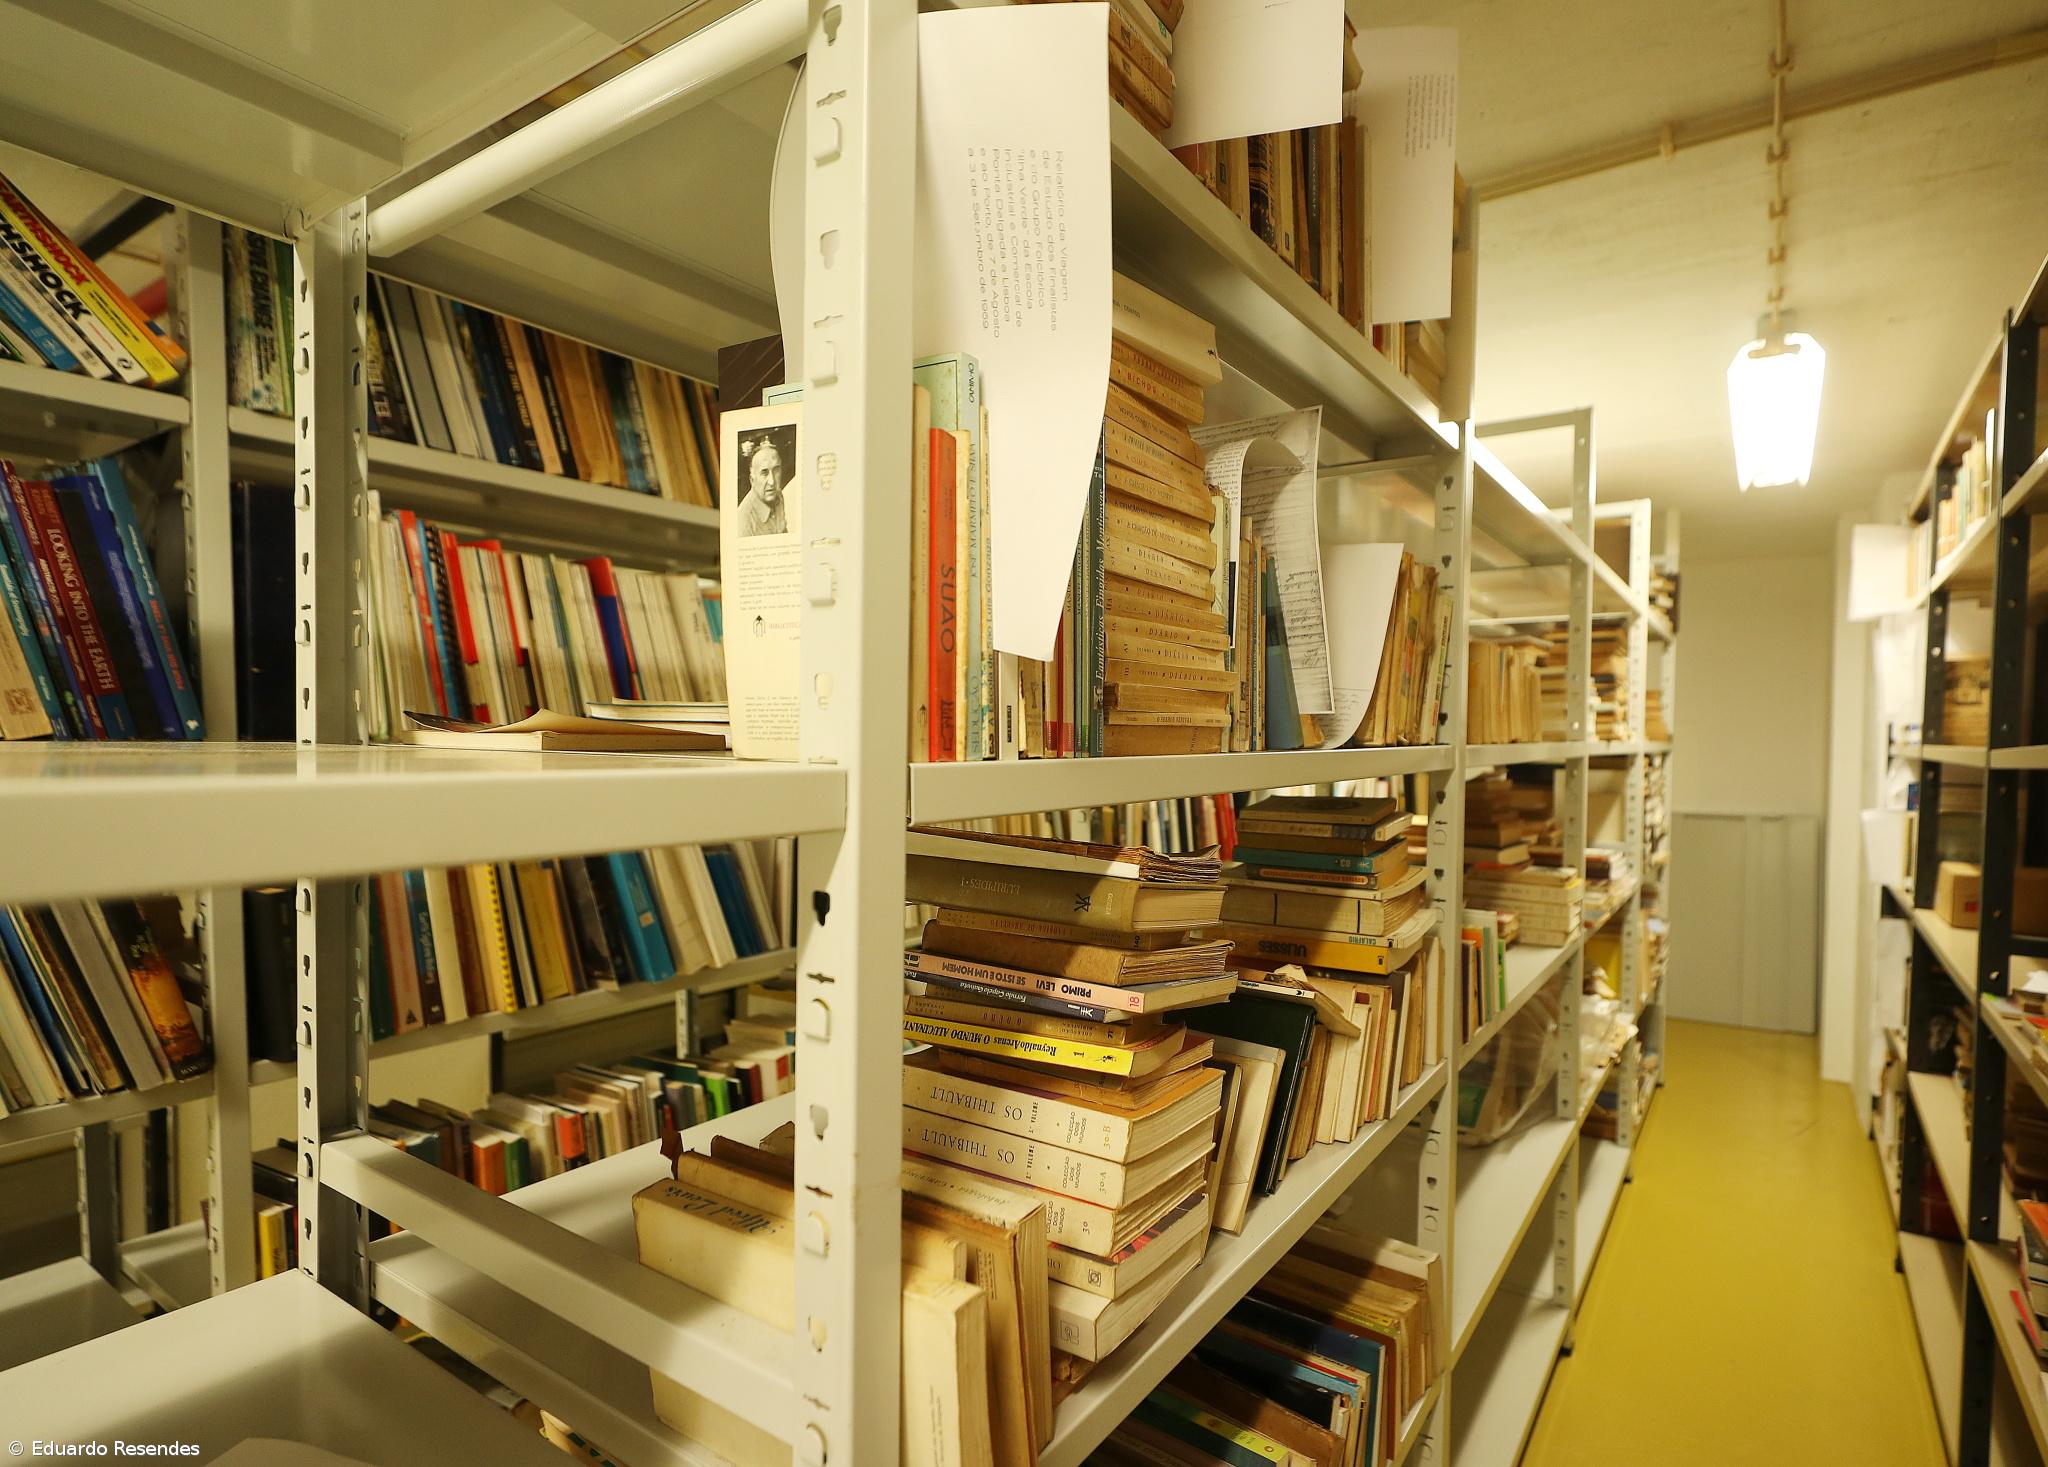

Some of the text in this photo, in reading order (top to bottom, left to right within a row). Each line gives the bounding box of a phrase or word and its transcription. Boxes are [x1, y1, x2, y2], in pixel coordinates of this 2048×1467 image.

[1042, 149, 1051, 169] de
[992, 149, 1002, 193] Ponta
[1043, 175, 1054, 231] Estudo
[1032, 190, 1042, 237] Grupo
[970, 178, 978, 197] de
[979, 277, 987, 294] de
[995, 199, 1007, 259] Delgada
[1058, 222, 1066, 241] da
[986, 233, 994, 250] de
[1023, 239, 1031, 258] da
[1047, 234, 1055, 262] dos
[990, 269, 998, 286] de
[1059, 246, 1068, 301] Viagem
[1024, 263, 1035, 310] Escola
[1002, 277, 1011, 322] Lisboa
[991, 291, 1001, 338] Agosto
[1015, 311, 1023, 328] de
[1127, 371, 1158, 394] BICHOS
[45, 524, 116, 692] LOOKING INTO THE EARTH
[1148, 625, 1179, 640] DIÁRIO
[1094, 615, 1105, 681] Fantásticas
[986, 652, 994, 669] de
[1169, 671, 1198, 682] DIÁRIO
[970, 878, 1021, 895] EURIPIDES
[1258, 939, 1307, 958] ULISSES
[1348, 935, 1377, 946] CALAFRIO
[942, 962, 974, 977] HOMEM
[976, 970, 988, 979] UM
[996, 973, 1015, 983] ISTO
[959, 981, 983, 993] Gaivota
[1016, 975, 1026, 985] SE
[1035, 979, 1056, 992] LEVI
[982, 986, 1005, 998] Capelo
[1006, 991, 1027, 1003] Fernão
[1060, 984, 1092, 998] PRIMO
[1129, 996, 1140, 1007] 18
[904, 1021, 950, 1038] ALUCINANT
[950, 1029, 983, 1044] MUNDO
[983, 1034, 990, 1044] O
[993, 1037, 1021, 1050] Arenas
[1021, 1040, 1057, 1056] Reynaldo
[930, 1086, 1023, 1121] OS THIBAULT
[1078, 1117, 1087, 1145] MUNDOS
[921, 1128, 1015, 1164] OS THIBAULT
[1074, 1162, 1082, 1189] MUNDOS
[1057, 1207, 1066, 1235] MUNDOS
